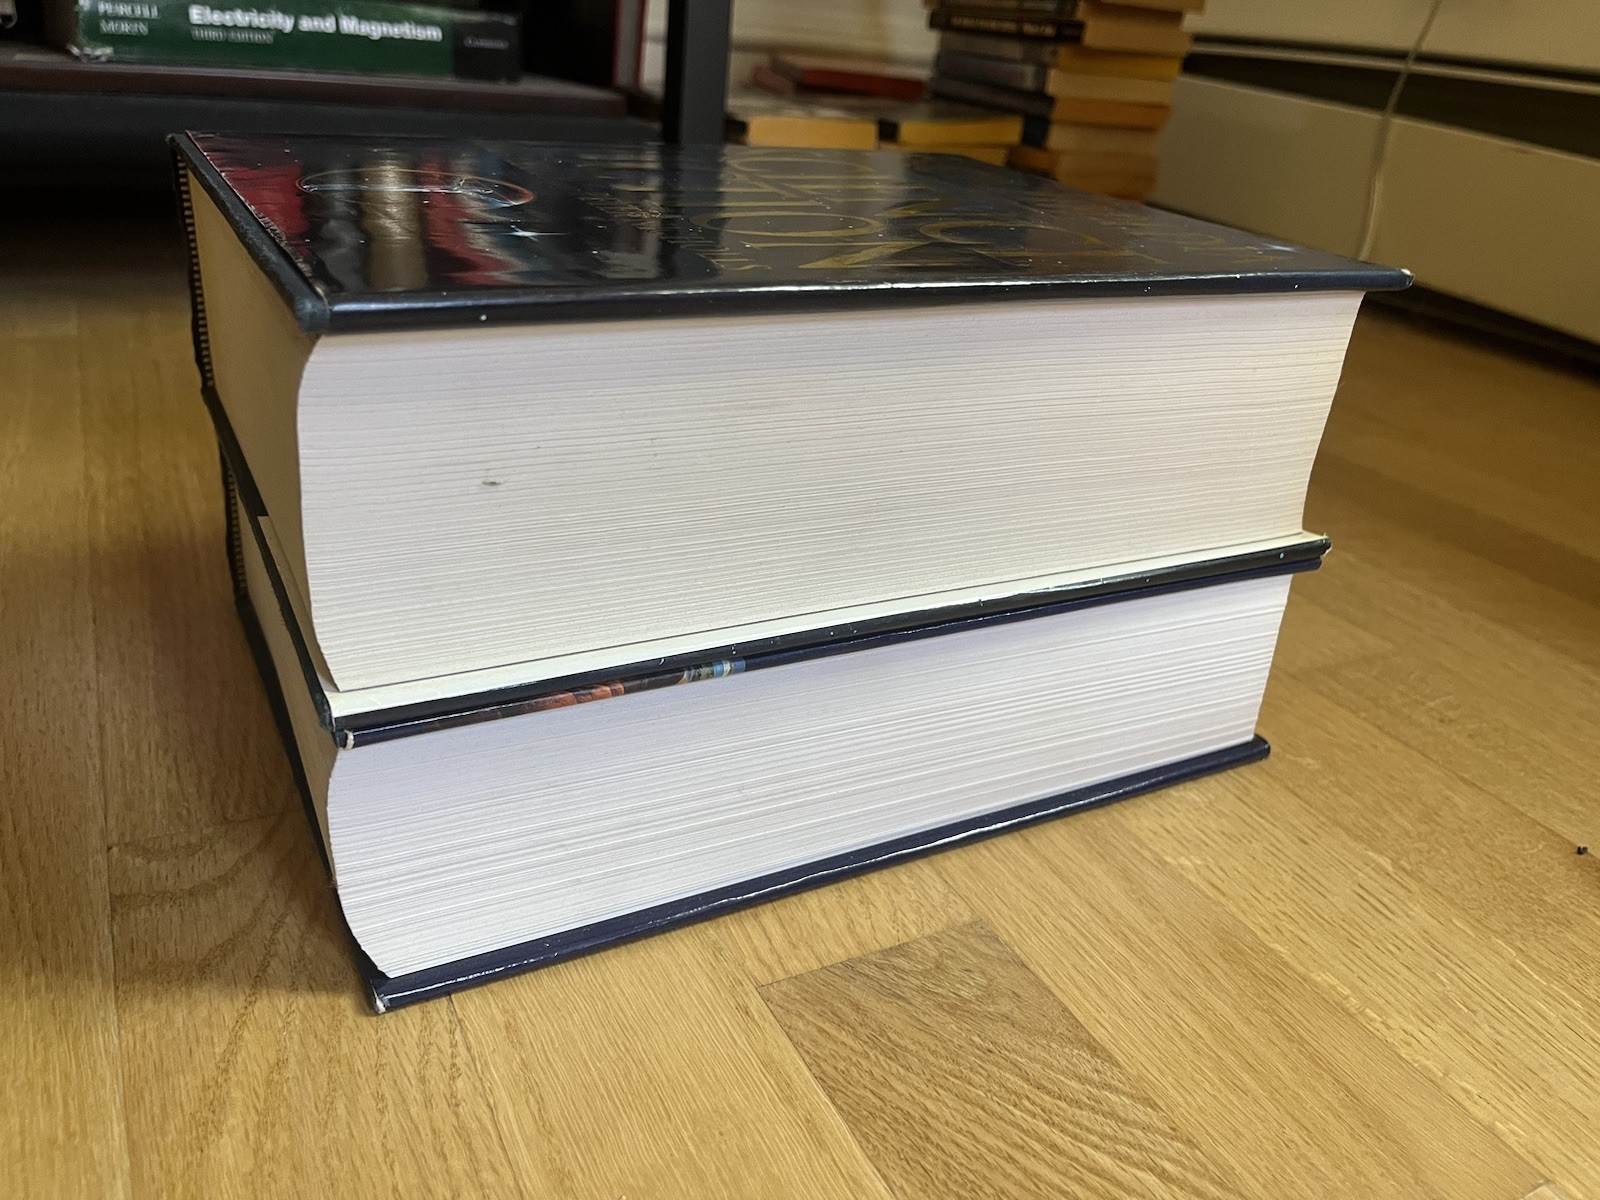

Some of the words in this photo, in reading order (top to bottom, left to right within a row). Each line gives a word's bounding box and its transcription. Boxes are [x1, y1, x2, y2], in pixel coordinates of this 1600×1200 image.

[190, 4, 295, 33] Electricity
[298, 14, 336, 33] and
[338, 14, 443, 41] Magnetism
